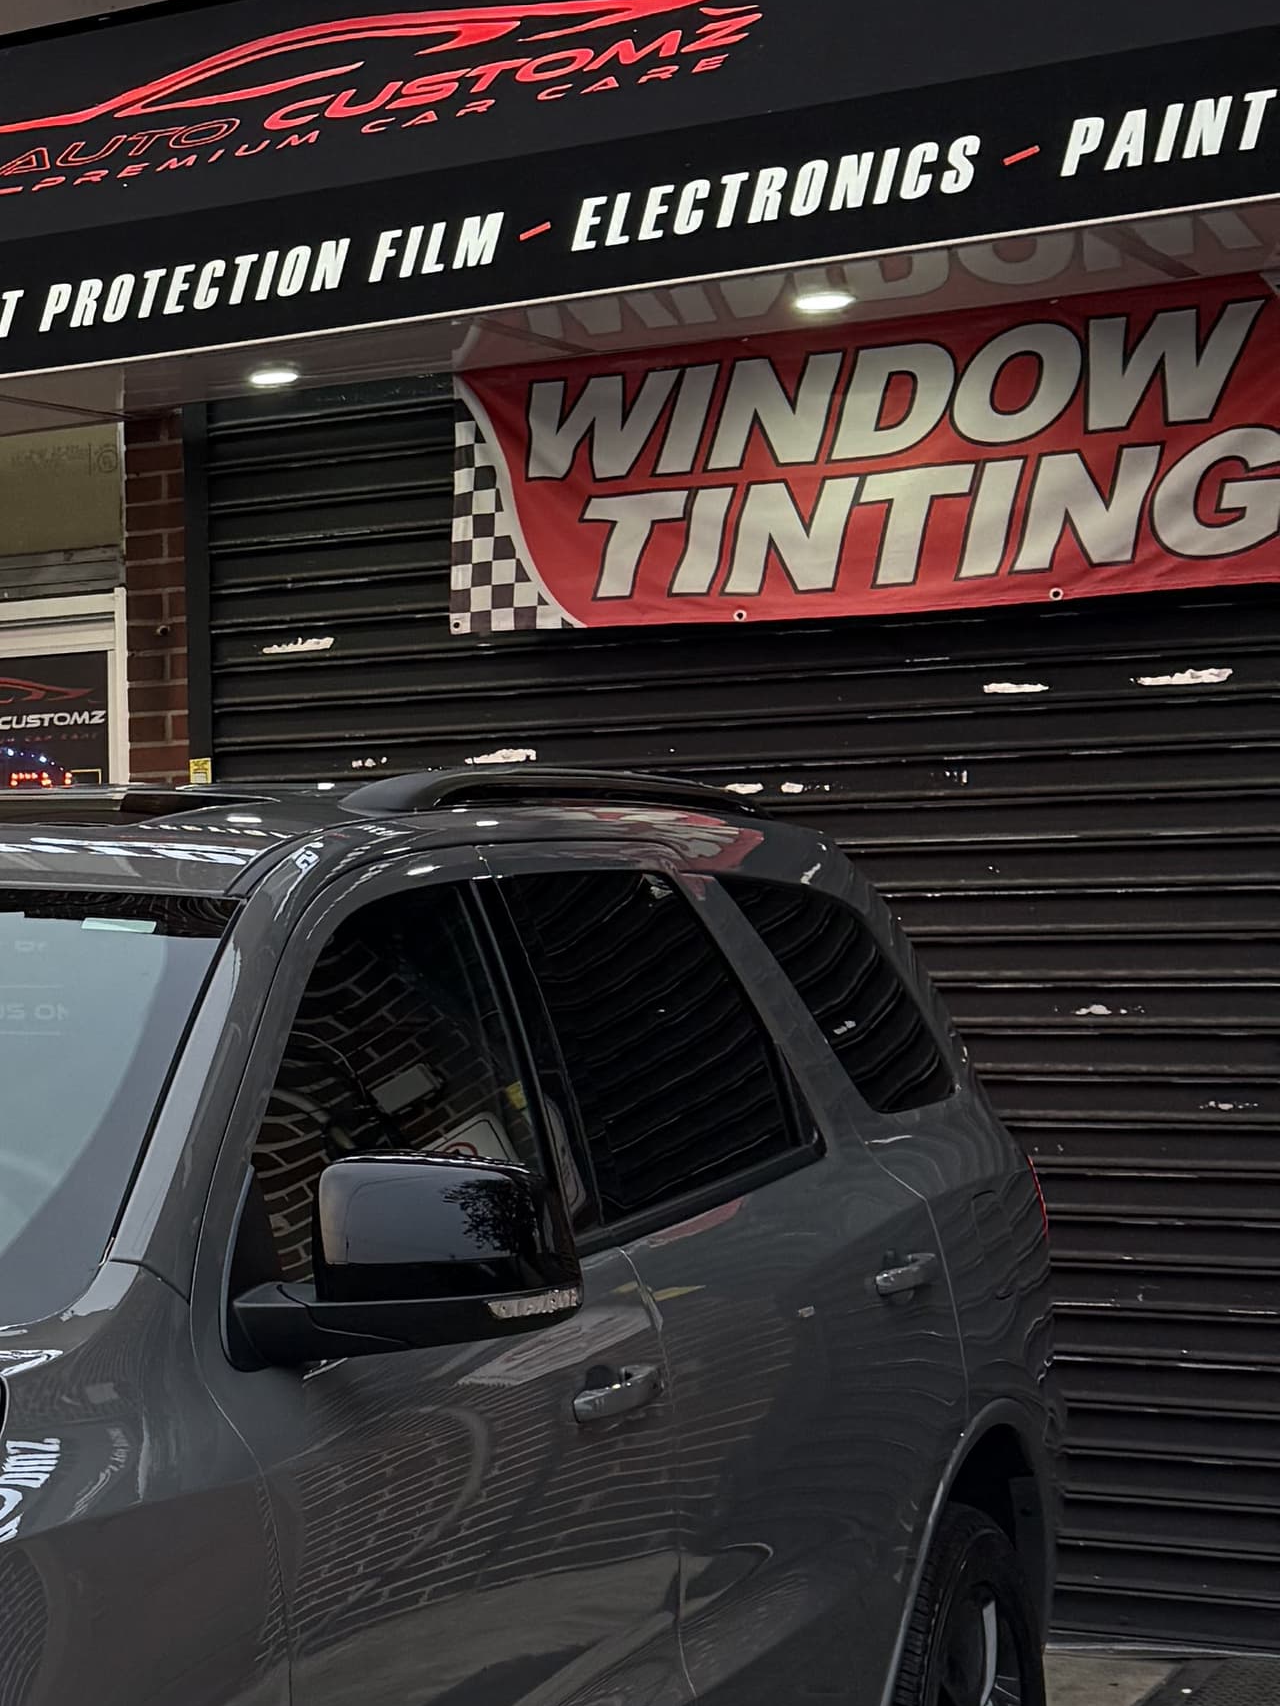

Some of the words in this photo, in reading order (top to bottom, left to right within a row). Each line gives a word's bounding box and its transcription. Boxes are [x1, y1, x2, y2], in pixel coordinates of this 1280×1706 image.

[31, 128, 323, 193] PREMIUM
[360, 102, 492, 135] CAR
[535, 53, 729, 103] CARE
[263, 4, 764, 133] CUSTOMZ
[39, 236, 353, 334] PROTECTION
[367, 211, 508, 287] FILM
[569, 134, 982, 253] ELECTRONICS
[1060, 89, 1278, 178] PAINT
[524, 297, 1268, 483] WINDOW
[579, 423, 1280, 603] TINTING
